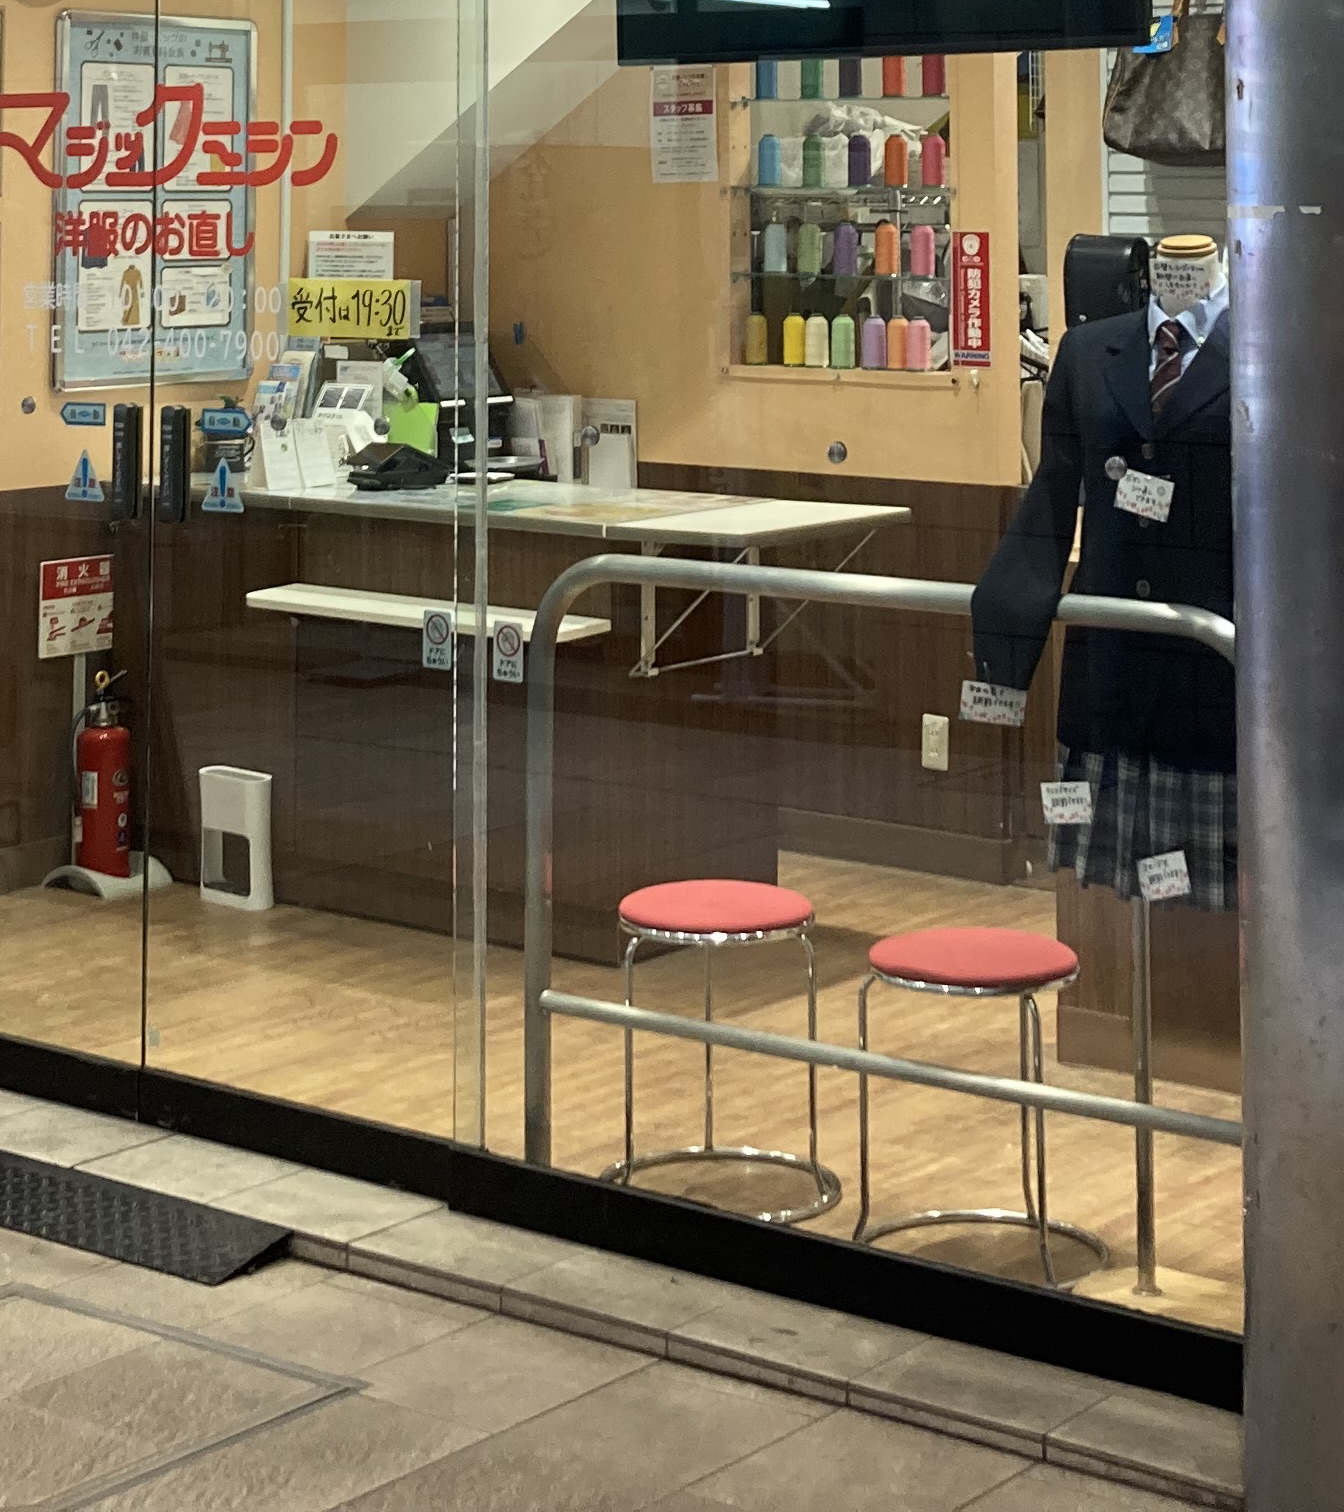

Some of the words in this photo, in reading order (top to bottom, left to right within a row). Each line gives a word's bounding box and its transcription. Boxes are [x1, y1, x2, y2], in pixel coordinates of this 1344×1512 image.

[133, 45, 185, 58] お直料金表
[56, 210, 256, 258] 洋服のお直し
[291, 286, 407, 327] 受付は19:30
[107, 326, 280, 362] 042-400-7900
